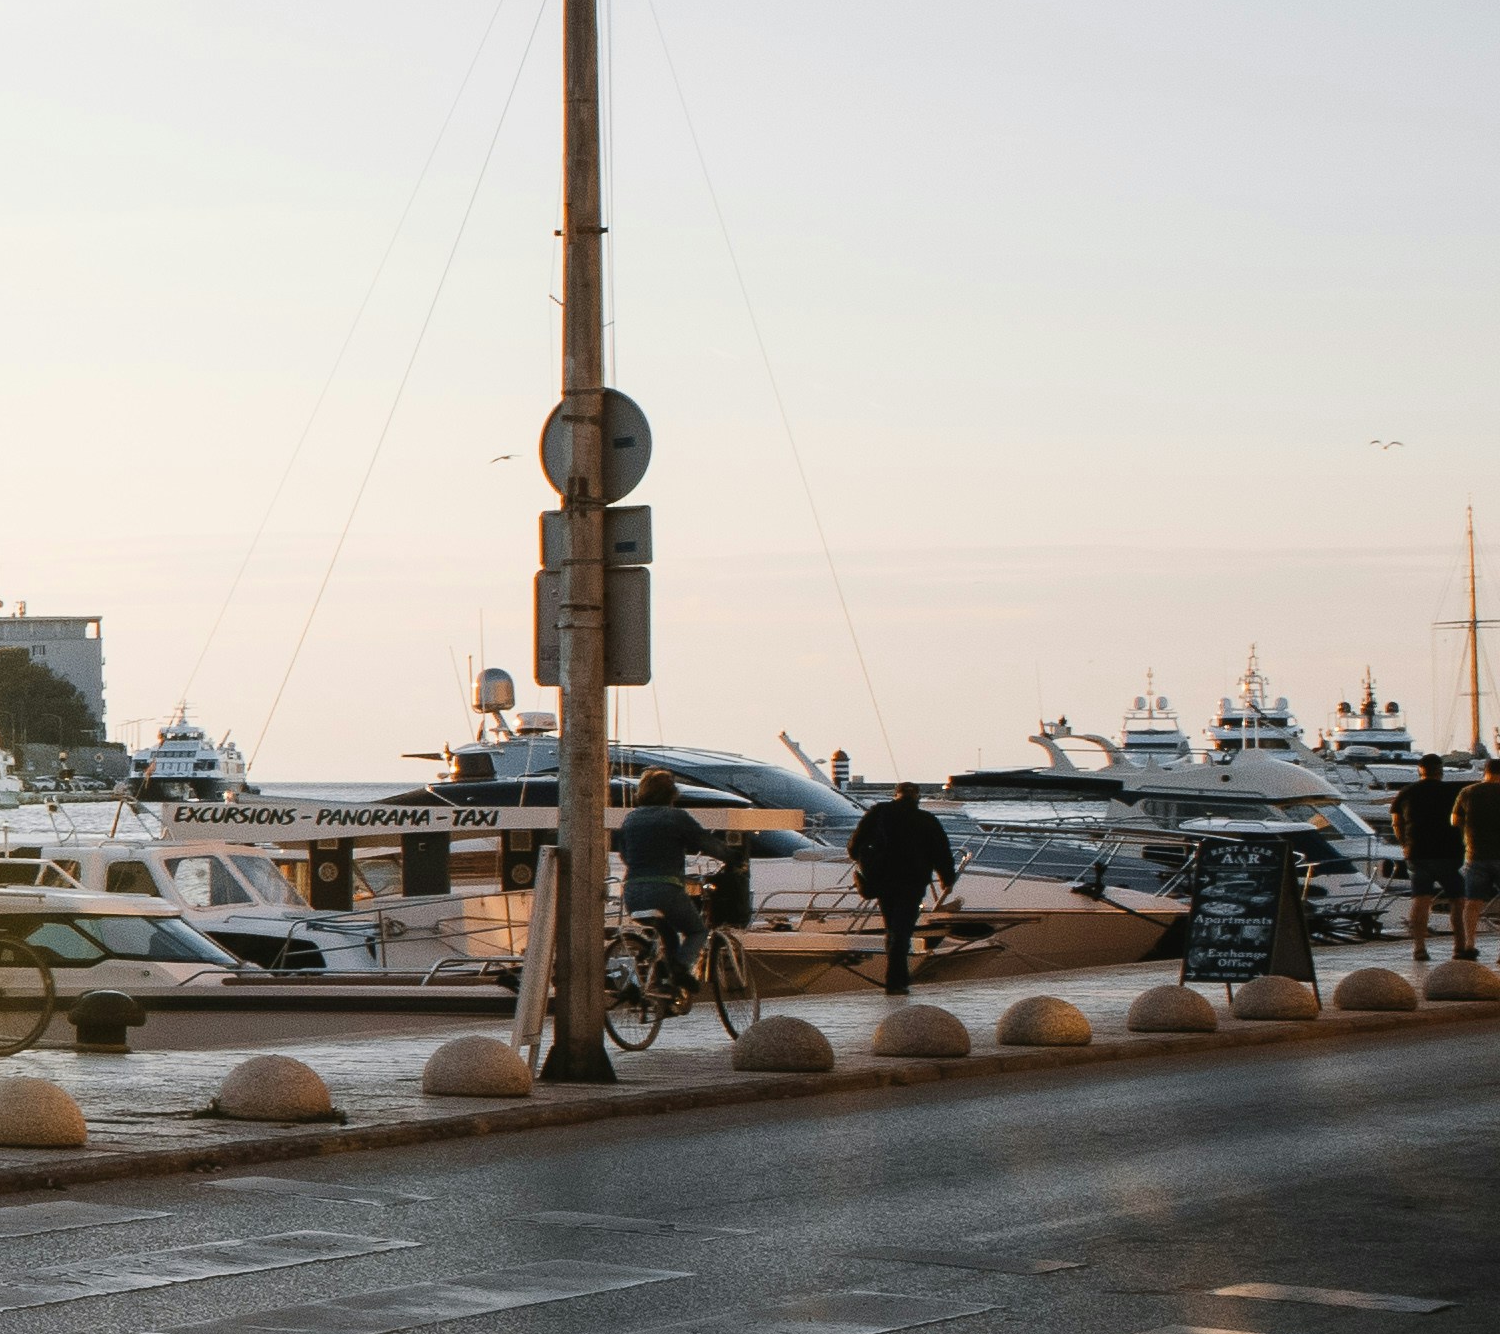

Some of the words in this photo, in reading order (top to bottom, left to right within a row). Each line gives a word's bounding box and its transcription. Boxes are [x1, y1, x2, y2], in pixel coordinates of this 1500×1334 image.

[174, 806, 298, 825] EXCURSIONS
[316, 808, 431, 826] PANORAMA
[452, 809, 500, 827] TAXI
[1210, 846, 1239, 857] RENT
[1194, 914, 1273, 926] Apartments
[1207, 948, 1268, 960] Exchange
[1218, 958, 1254, 968] Office
